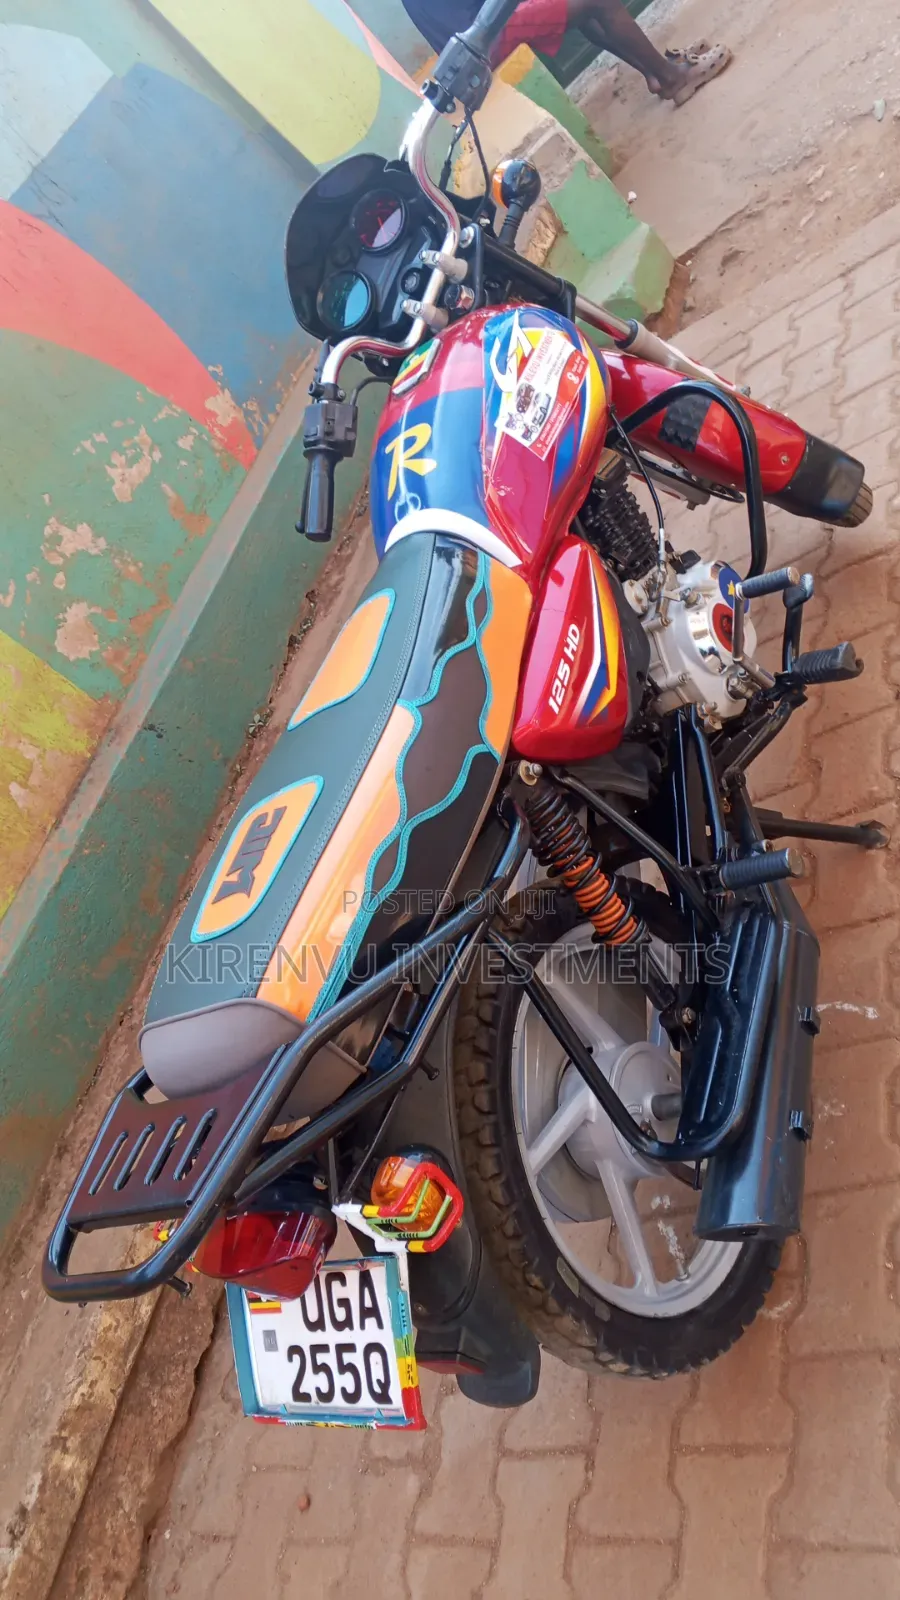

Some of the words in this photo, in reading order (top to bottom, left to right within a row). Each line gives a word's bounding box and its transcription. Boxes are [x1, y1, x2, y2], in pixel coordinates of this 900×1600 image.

[384, 422, 437, 501] R
[548, 658, 571, 714] 125
[564, 623, 580, 660] HD
[301, 1269, 384, 1332] UGA
[287, 1342, 393, 1405] 255Q
